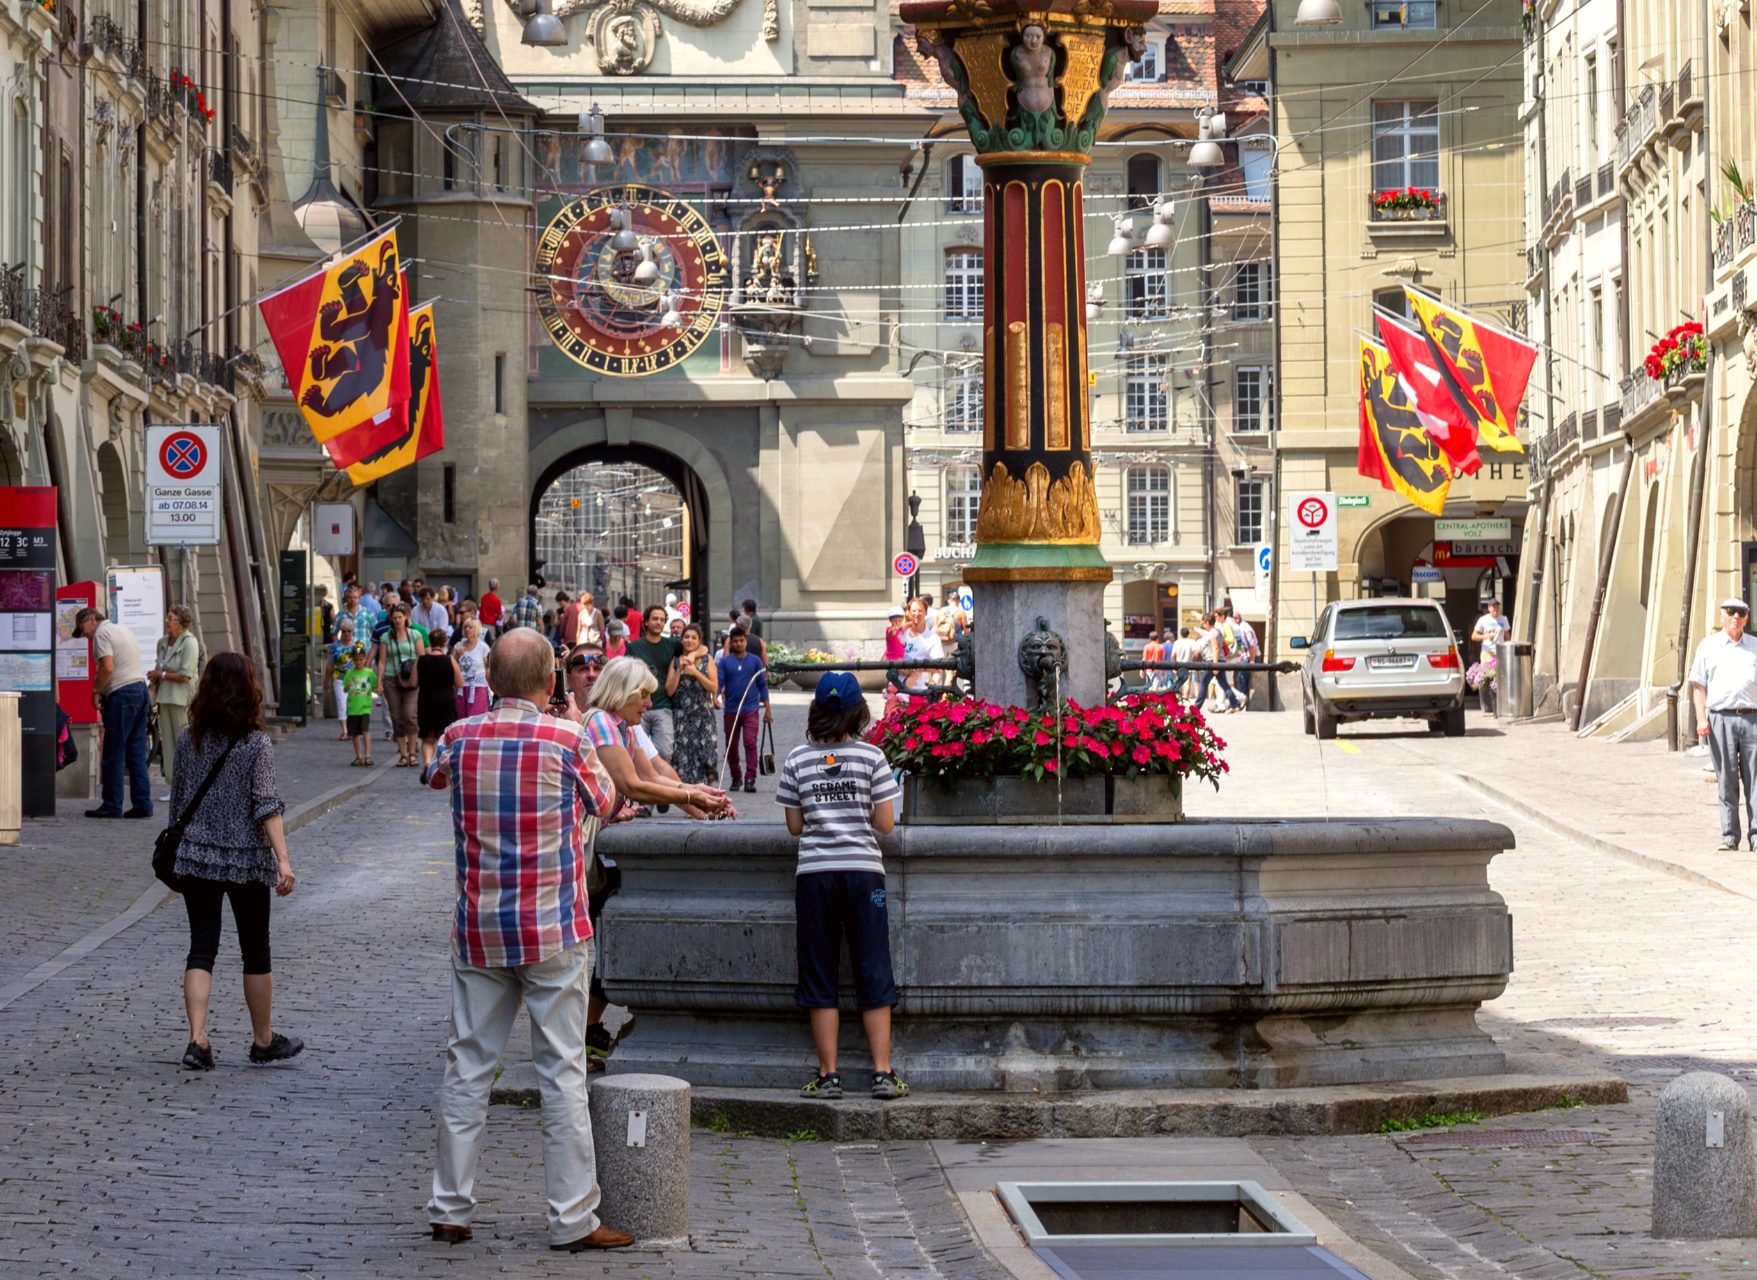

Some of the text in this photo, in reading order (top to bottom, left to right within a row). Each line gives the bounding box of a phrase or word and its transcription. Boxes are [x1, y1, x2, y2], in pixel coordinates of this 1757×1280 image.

[154, 488, 212, 496] Ganze Gasse
[158, 501, 208, 510] ab 07.08.14
[170, 513, 197, 522] 13.00
[1436, 521, 1509, 530] CENTRAL-APOTHEKE
[0, 537, 10, 547] 12
[815, 791, 857, 802] STREET
